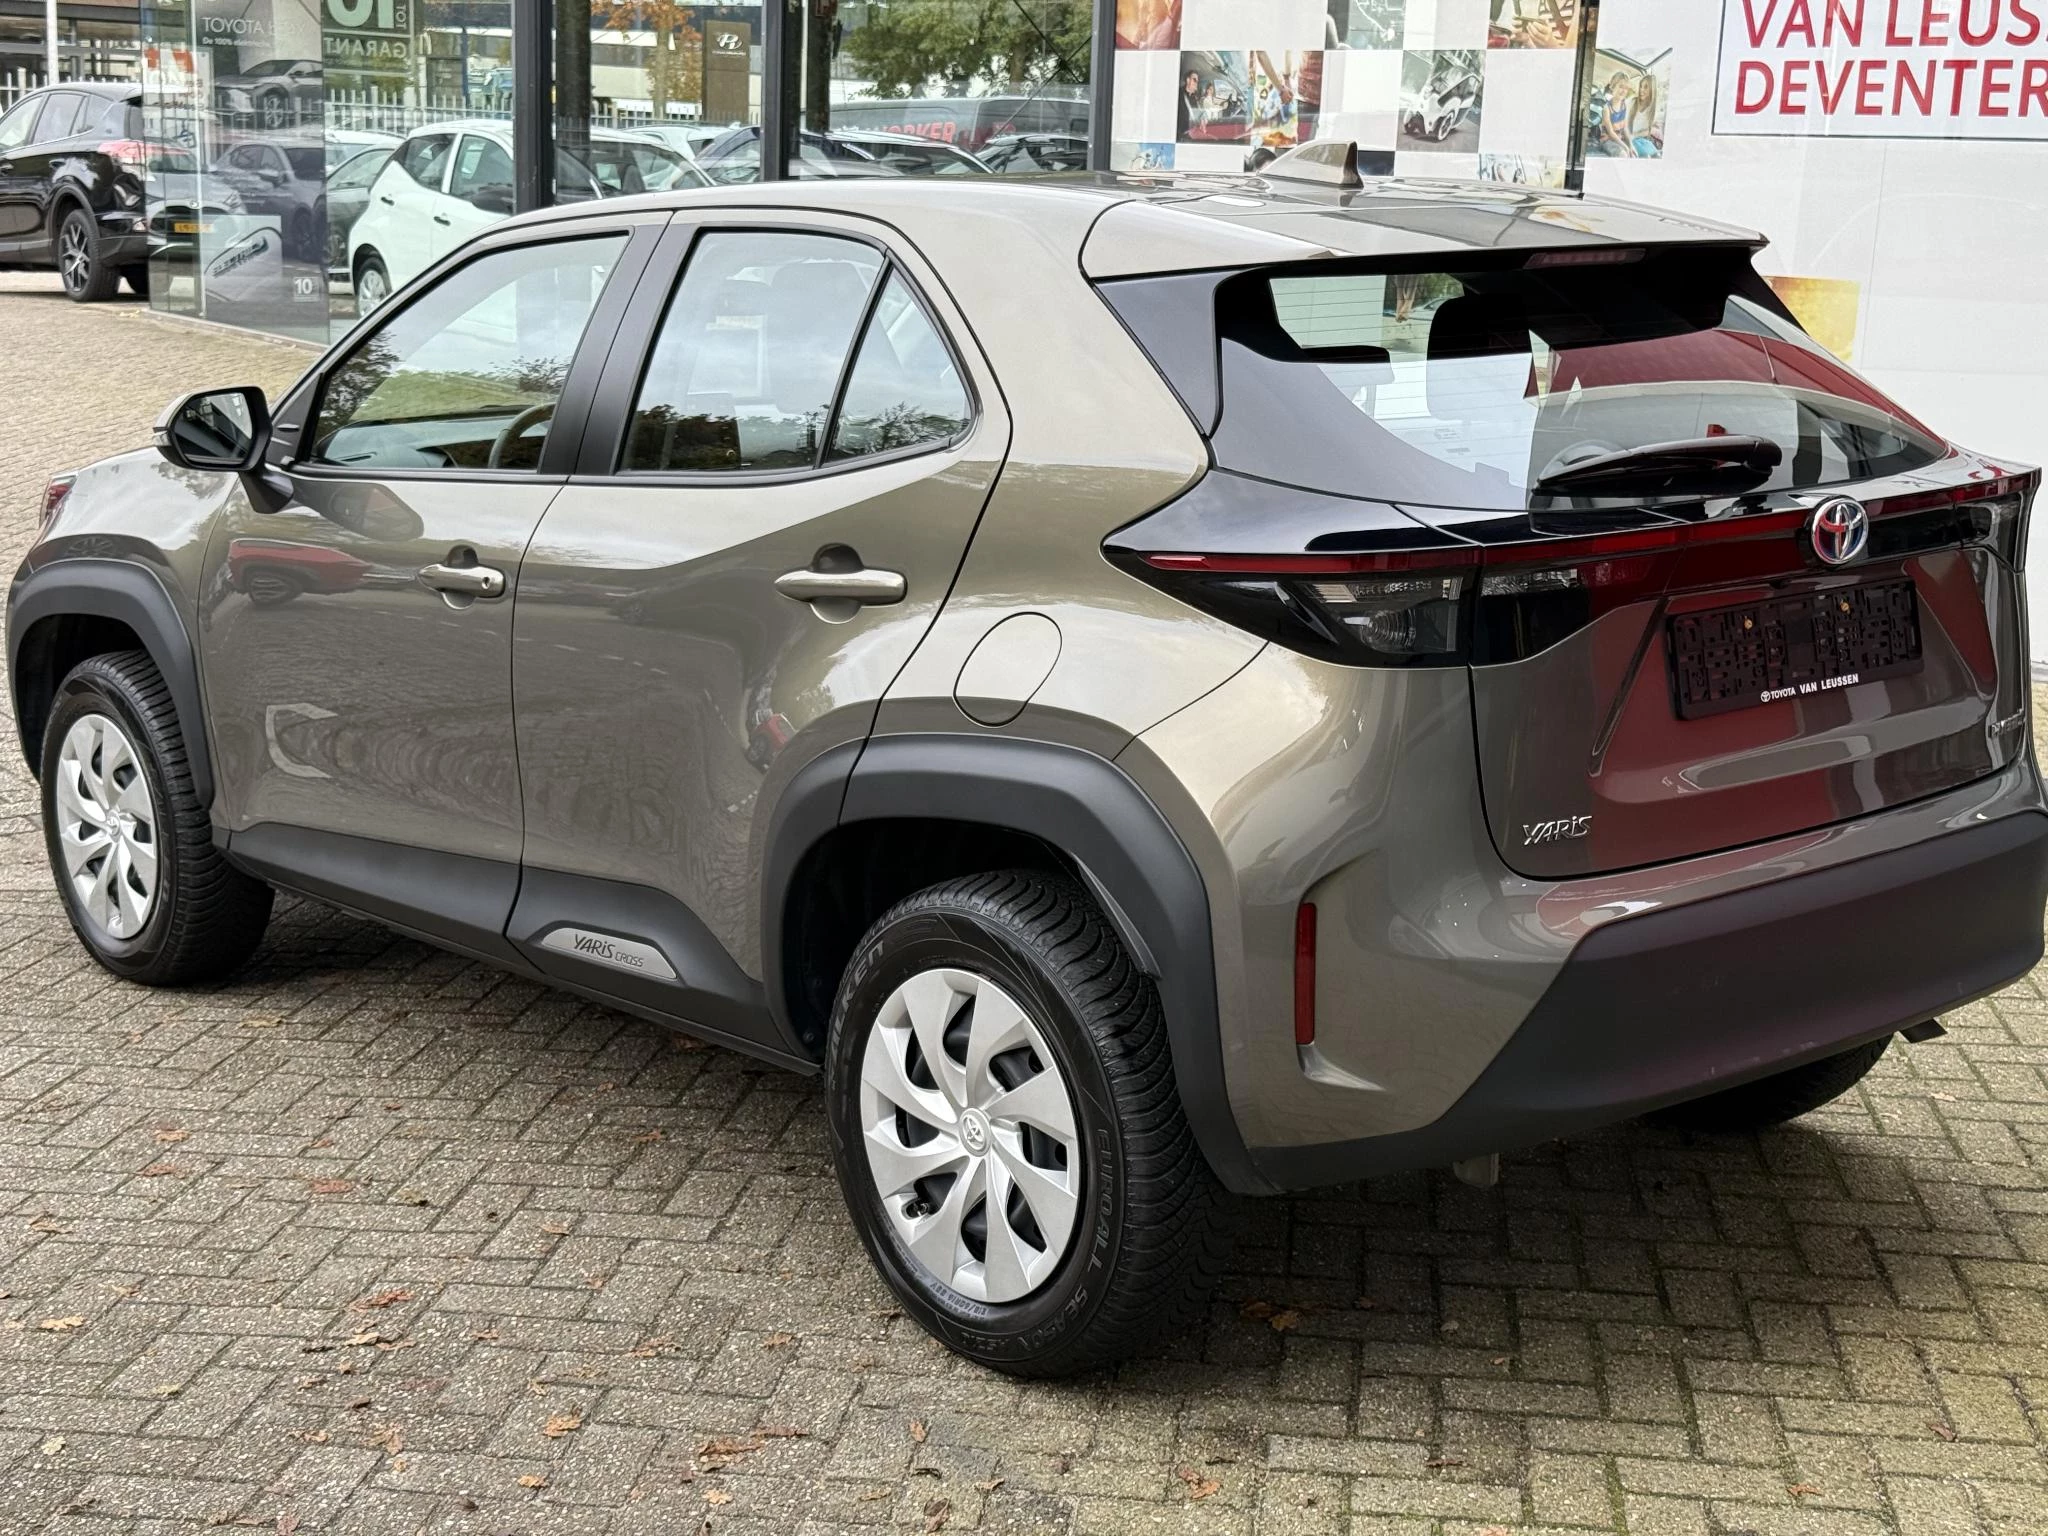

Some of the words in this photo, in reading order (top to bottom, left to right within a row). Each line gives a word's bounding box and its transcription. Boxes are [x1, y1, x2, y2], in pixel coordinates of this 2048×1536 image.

[200, 17, 264, 34] TOYOTA
[1743, 0, 1865, 48] VAN
[1884, 0, 2048, 47] LEUS
[1735, 59, 2048, 118] DEVENTER
[295, 278, 313, 295] 10
[1770, 687, 1796, 700] TOYOTA
[1799, 682, 1818, 694] VAN
[1821, 673, 1859, 690] LEUSSEN
[614, 951, 645, 968] CROSS
